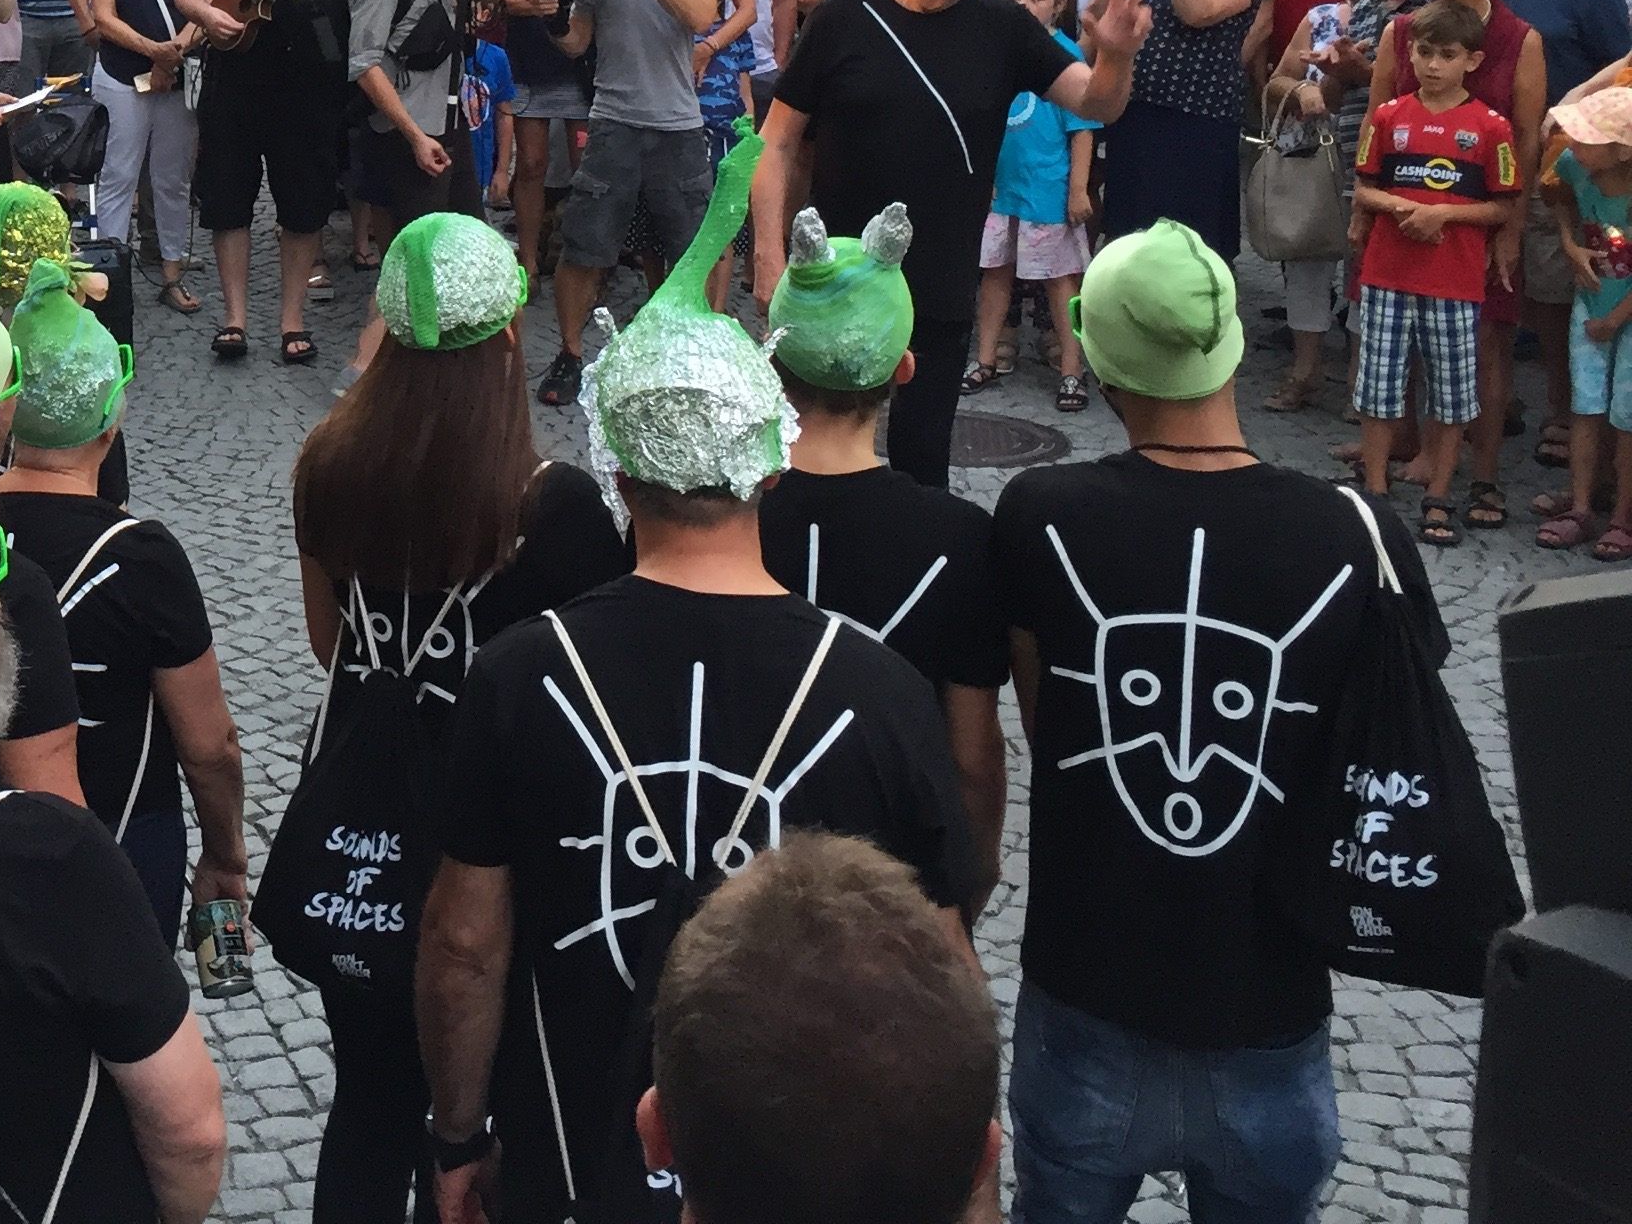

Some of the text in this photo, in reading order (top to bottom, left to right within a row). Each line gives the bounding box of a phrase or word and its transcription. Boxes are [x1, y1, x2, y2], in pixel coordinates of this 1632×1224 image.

[1394, 164, 1463, 183] CASHPOINT
[1329, 838, 1439, 888] SPACES
[346, 866, 382, 897] OF
[304, 892, 406, 932] SPACES
